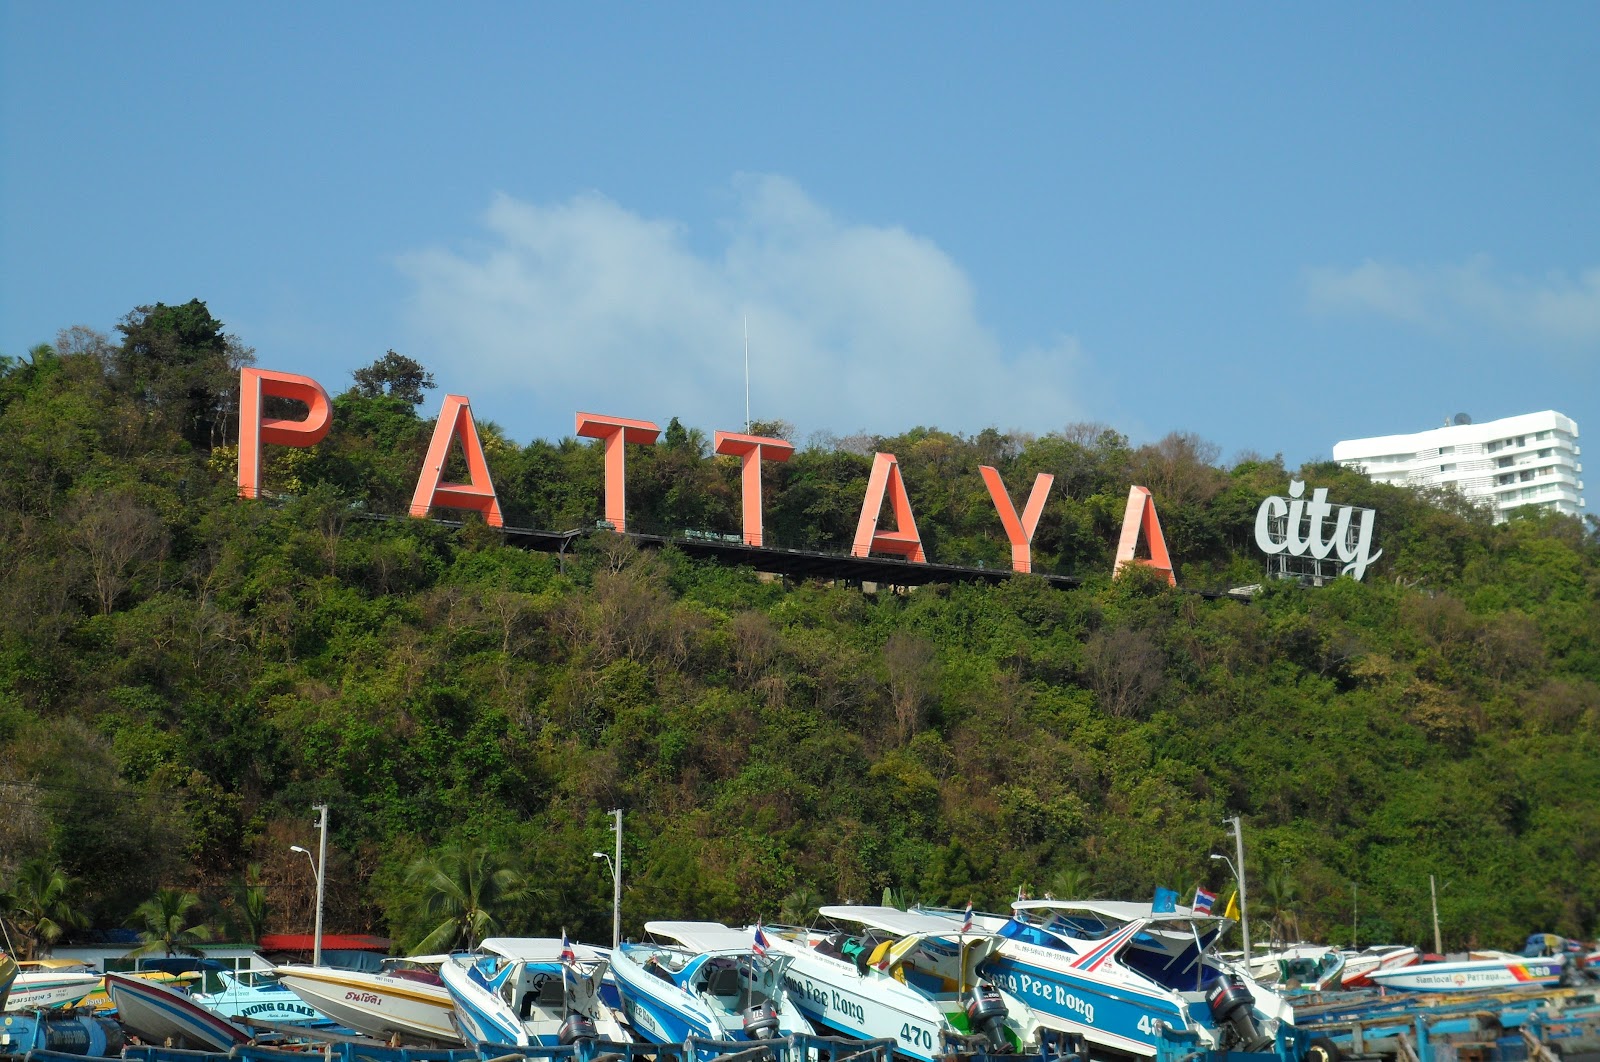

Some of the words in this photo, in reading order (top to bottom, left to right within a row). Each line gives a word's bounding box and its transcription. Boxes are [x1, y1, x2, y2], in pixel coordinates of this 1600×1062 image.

[237, 367, 1177, 587] PATTAYA
[1254, 480, 1383, 581] city
[1416, 975, 1434, 984] Siam
[1529, 966, 1550, 976] 260
[805, 980, 828, 1006] Pee
[1020, 974, 1052, 1001] Pee
[241, 1003, 275, 1017] NONG
[277, 1003, 315, 1017] GAME
[752, 1010, 764, 1019] 115
[900, 1022, 932, 1050] 470
